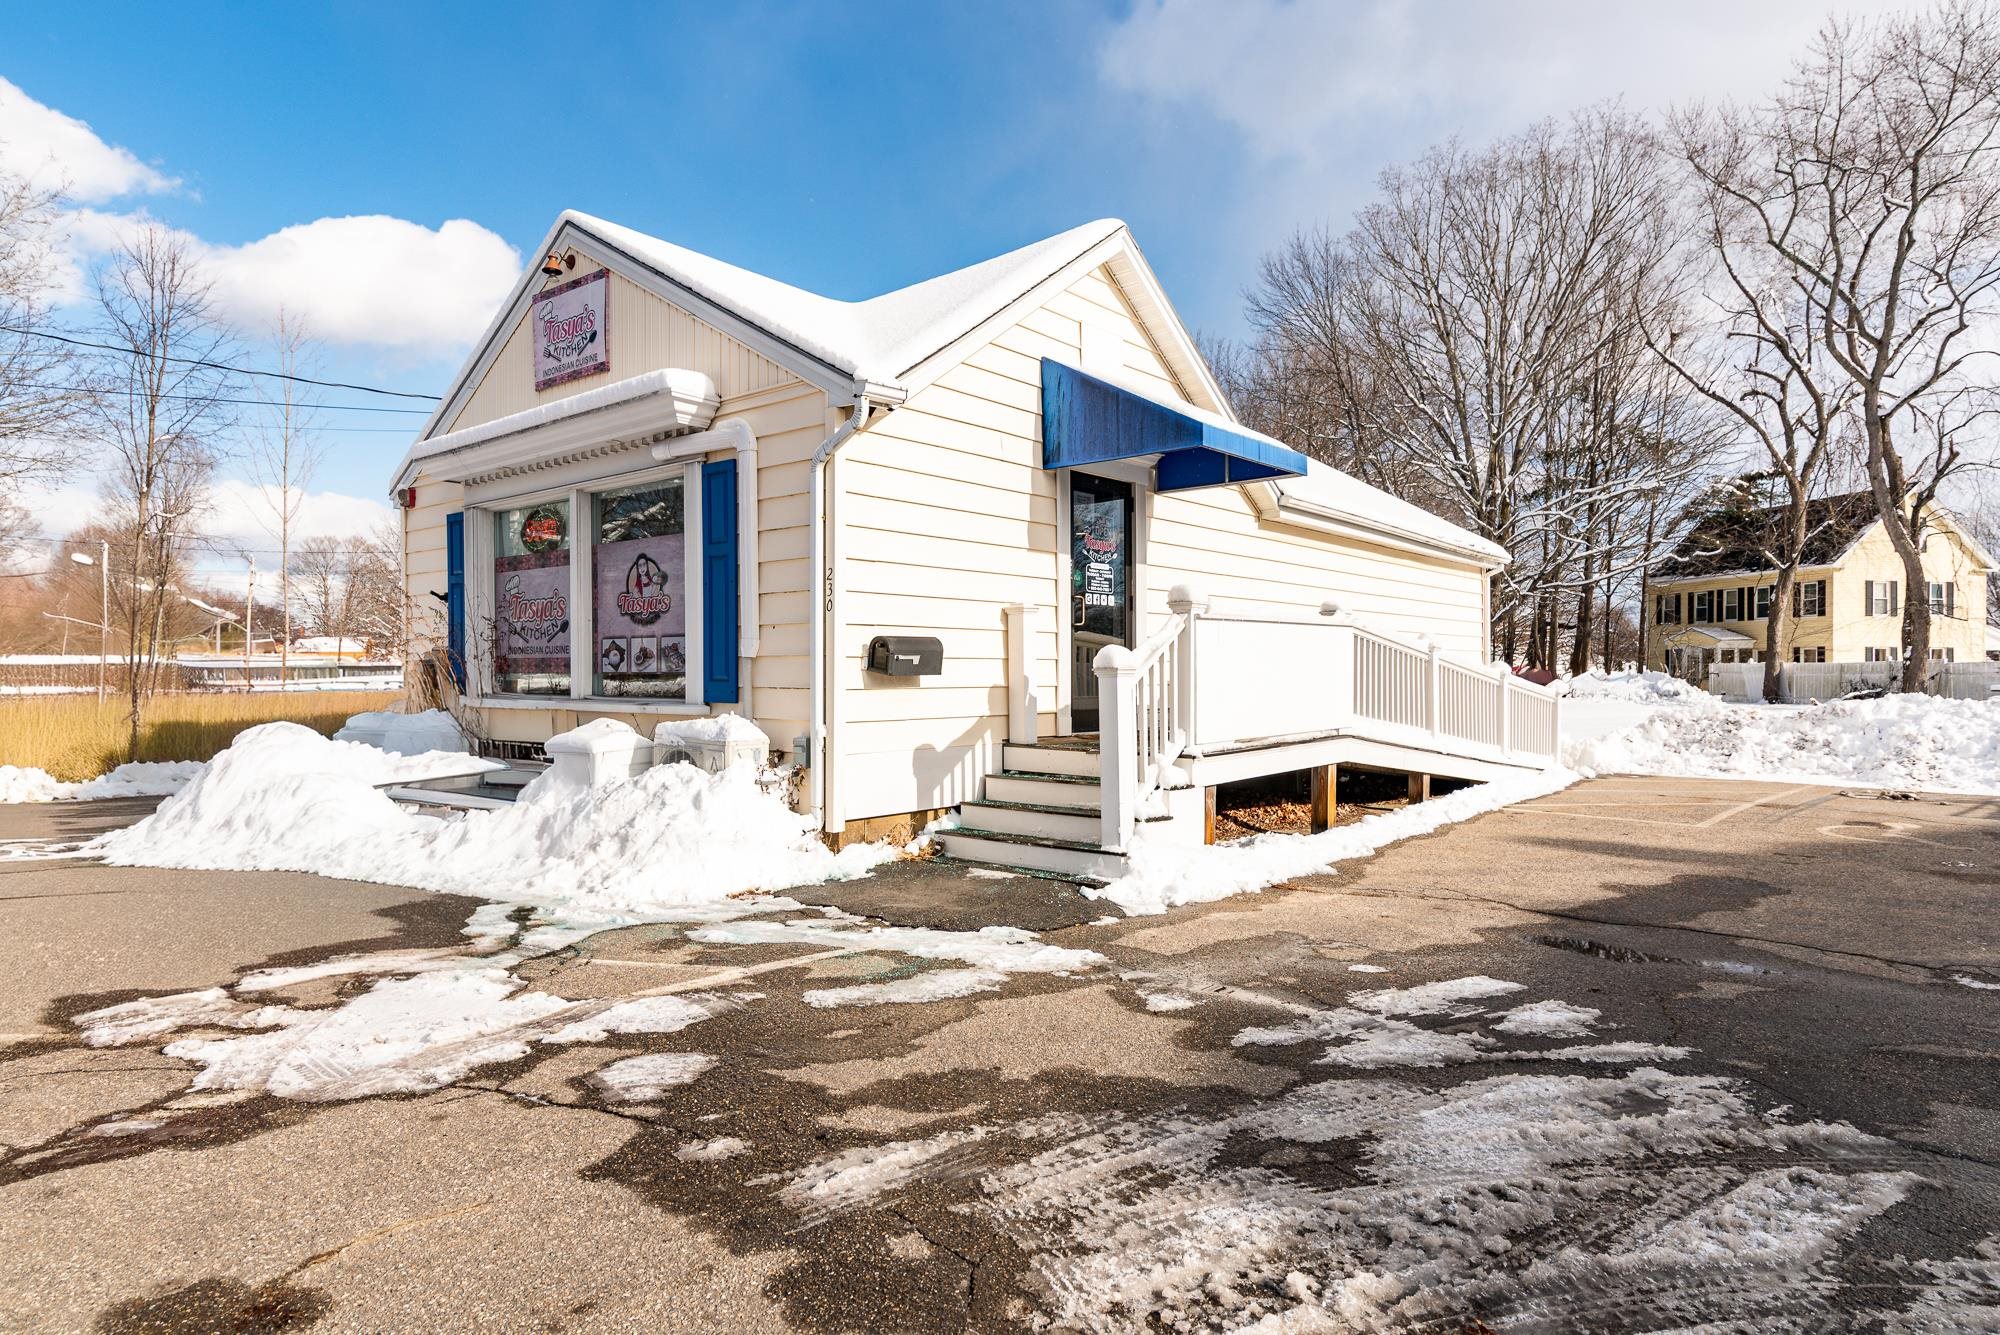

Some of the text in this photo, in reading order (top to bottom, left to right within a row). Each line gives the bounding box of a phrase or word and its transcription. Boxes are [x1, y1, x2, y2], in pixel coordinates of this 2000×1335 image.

[544, 304, 595, 346] Tasya's
[553, 333, 588, 357] KITCHEN
[543, 353, 598, 377] INDONESIAN CUISINE
[1089, 550, 1112, 563] KITCHEN
[510, 588, 566, 629] Tasya's
[618, 590, 670, 617] Tasya's
[520, 620, 559, 640] KITCHEN
[508, 645, 570, 655] INDONESIAN CUISINE
